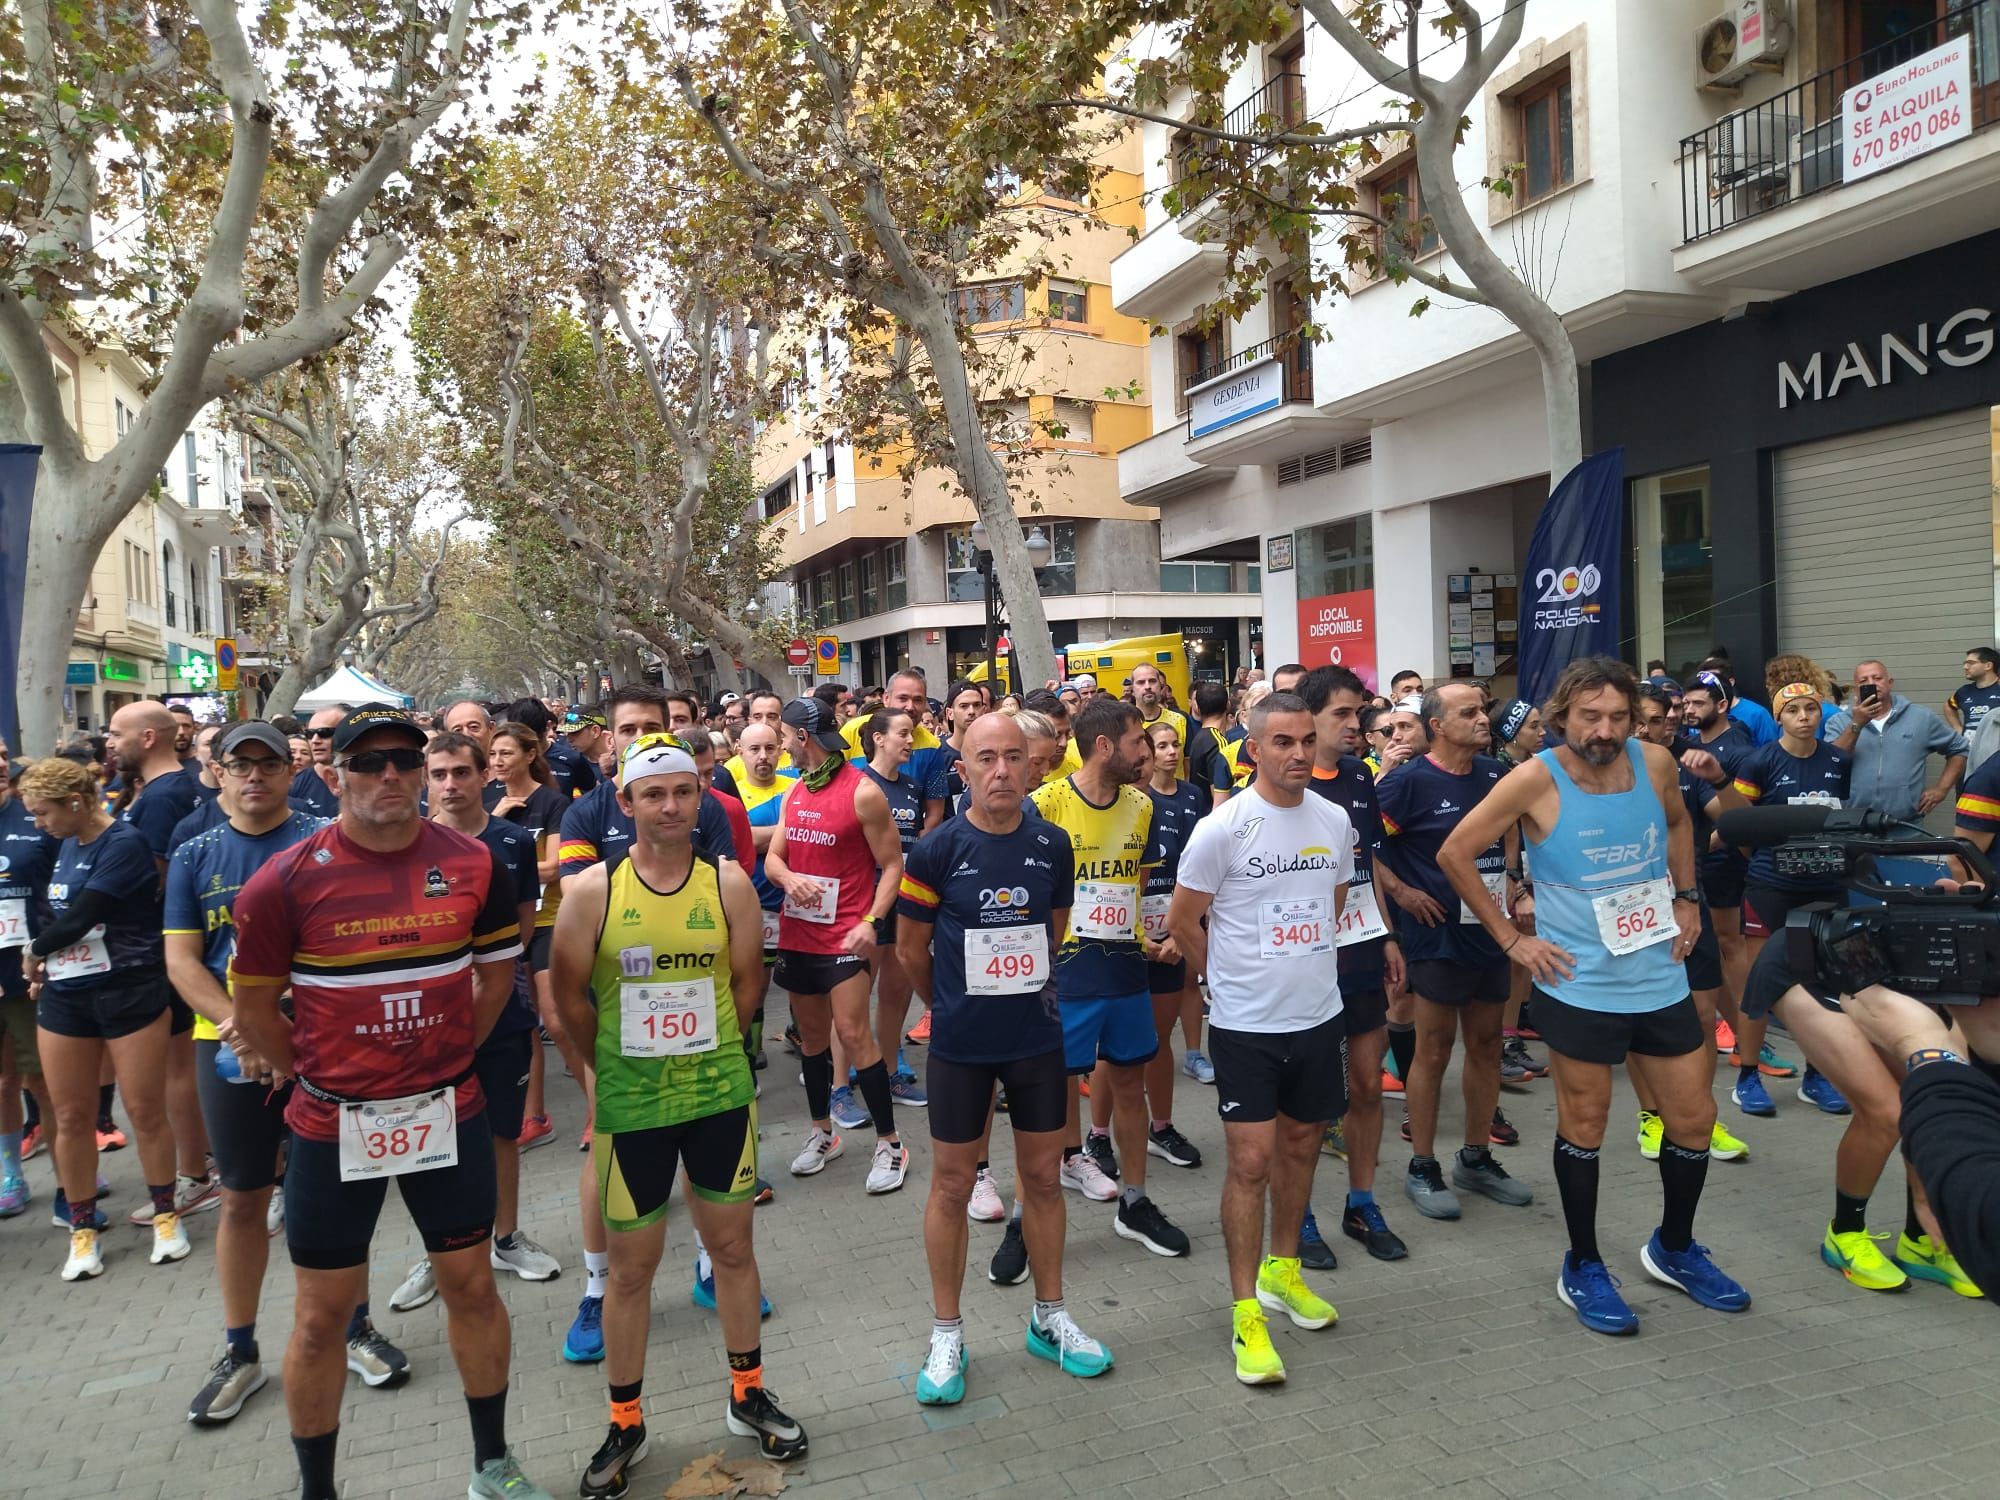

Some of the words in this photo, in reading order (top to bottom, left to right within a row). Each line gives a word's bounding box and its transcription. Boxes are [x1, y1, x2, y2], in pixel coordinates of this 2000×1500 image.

[1854, 116, 1873, 139] SE
[1878, 79, 1959, 129] ALQUILA
[1852, 137, 1884, 167] 670
[1889, 121, 1922, 153] 890
[1927, 104, 1961, 136] 086
[1213, 375, 1260, 407] GESDENIA
[1319, 606, 1349, 623] LOCAL
[1185, 626, 1214, 634] MACSON
[1310, 619, 1363, 638] DISPONIBLE
[1434, 805, 1460, 816] Santander
[810, 829, 837, 847] DURO
[979, 886, 1030, 909] 200
[334, 911, 458, 937] KAMIKAZES
[980, 910, 1019, 918] POLICIA
[981, 915, 1029, 924] NACIONAL
[1088, 904, 1128, 926] 480
[1616, 907, 1658, 938] 562
[378, 931, 421, 945] GANG
[1271, 922, 1321, 947] 3401
[985, 953, 1034, 979] 499
[355, 1013, 445, 1035] MARTINEZ
[642, 1011, 697, 1040] 150
[367, 1124, 432, 1159] 387
